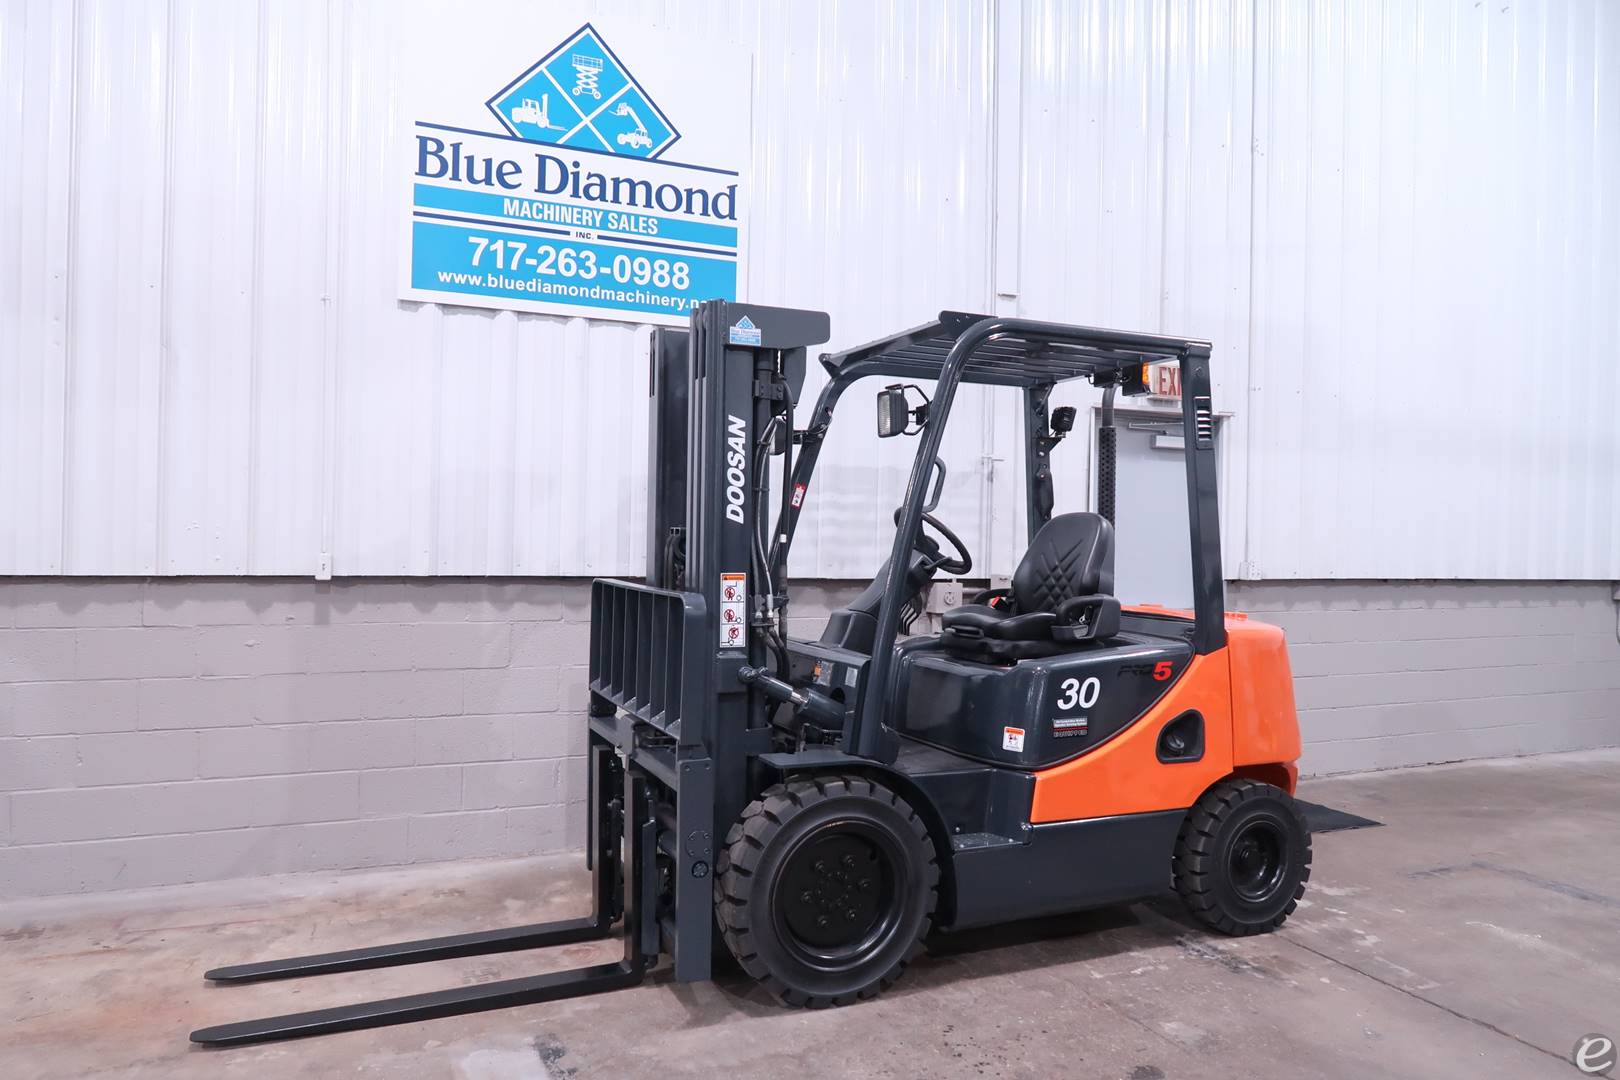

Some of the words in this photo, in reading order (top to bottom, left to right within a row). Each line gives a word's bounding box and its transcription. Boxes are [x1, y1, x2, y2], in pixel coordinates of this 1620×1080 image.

[415, 135, 522, 189] Blue
[534, 153, 738, 220] Diamond
[503, 198, 603, 227] MACHINERY
[607, 212, 659, 235] SALES
[575, 231, 595, 240] INC.
[468, 236, 690, 290] 717-263-0988
[438, 271, 712, 310] www.bluediamondmachinery.n
[1159, 366, 1182, 396] EXI
[726, 414, 746, 524] DOOSAN
[1057, 677, 1100, 710] 30
